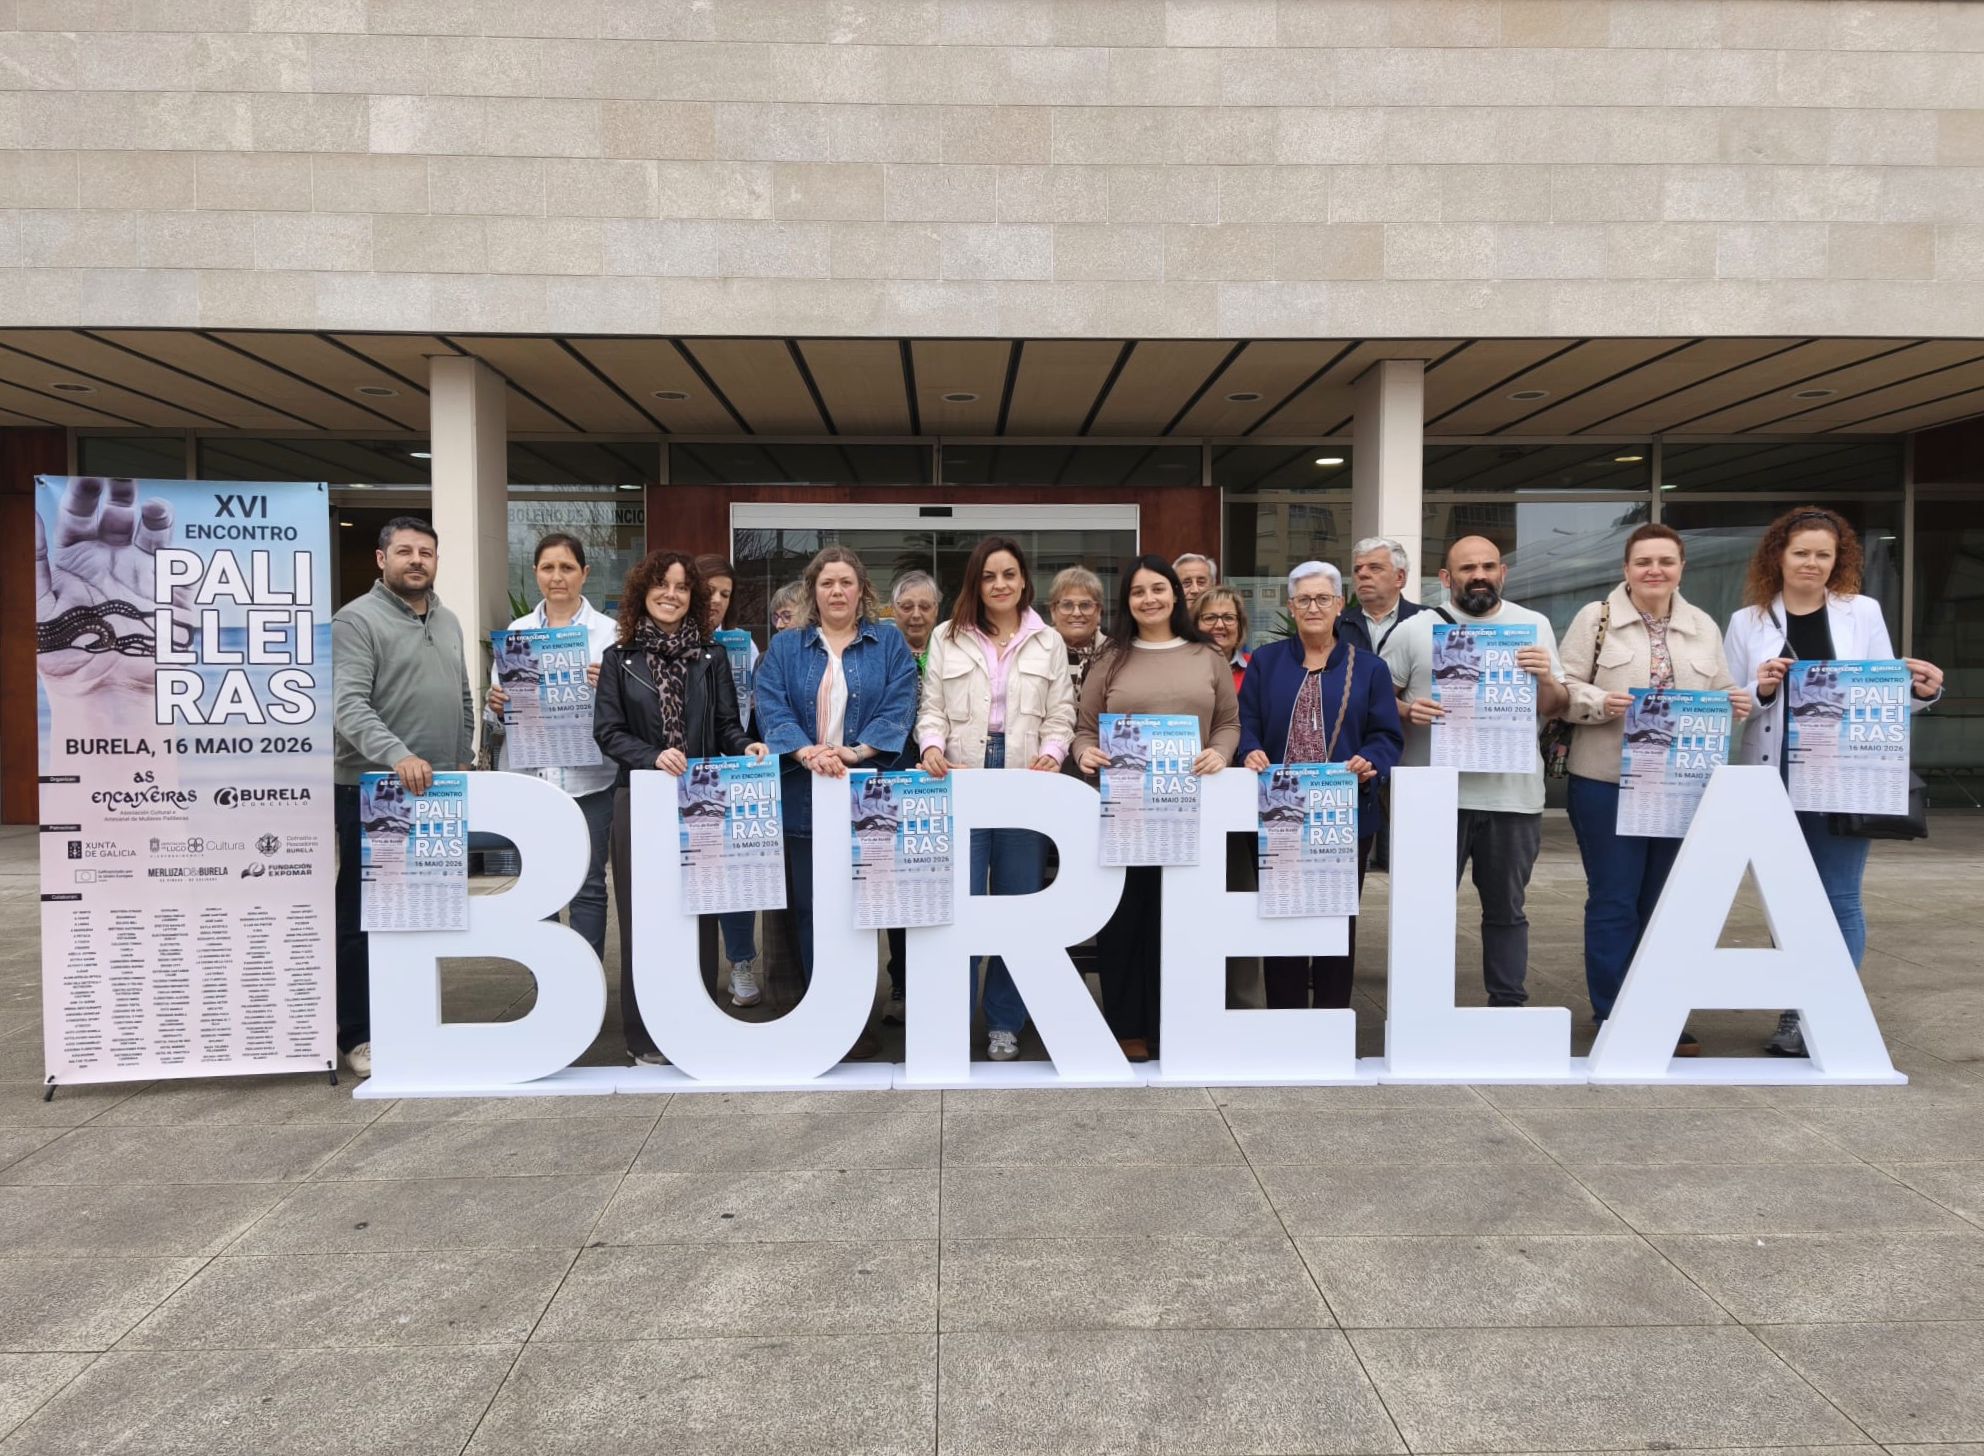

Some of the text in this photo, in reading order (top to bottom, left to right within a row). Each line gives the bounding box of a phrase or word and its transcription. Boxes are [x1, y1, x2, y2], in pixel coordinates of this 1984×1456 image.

[214, 494, 267, 518] XVI
[185, 524, 298, 541] ENCONTRO
[154, 548, 313, 605] PALI
[154, 608, 314, 665] LLEI
[552, 642, 584, 650] ENCONTRO
[541, 650, 587, 669] PALI
[1485, 650, 1520, 666] PA
[544, 667, 588, 687] LLEI
[1485, 667, 1532, 685] LLEI
[154, 668, 316, 725] RAS
[547, 686, 591, 704] RAS
[1485, 687, 1532, 703] RAS
[1850, 686, 1904, 704] PALI
[1850, 705, 1904, 723] LLEI
[1679, 715, 1726, 733] PALI
[1850, 724, 1905, 742] RAS
[66, 737, 313, 758] BURELA, 16 MAIO 2026
[1151, 739, 1197, 755] PALI
[1677, 733, 1725, 751] LLEI
[1675, 752, 1724, 770] RAS
[730, 781, 776, 801] PALI
[1152, 776, 1197, 794] RAS
[240, 788, 311, 801] BURELA
[1309, 789, 1353, 807] PALI
[415, 800, 462, 818] PALI
[731, 800, 777, 820] LLEI
[902, 797, 948, 815] PALI
[903, 816, 949, 835] LLEI
[1310, 808, 1353, 826] LLEI
[415, 820, 463, 837] LLEI
[732, 820, 778, 839] RAS
[1310, 827, 1354, 845] RAS
[85, 841, 117, 850] XUNTA
[85, 849, 137, 858] DE GALICIA
[205, 840, 245, 851] Cultura
[415, 839, 463, 857] RAS
[903, 835, 949, 854] RAS
[148, 867, 184, 877] MERLUZA
[199, 866, 229, 876] BURELA
[368, 764, 1895, 1083] BURELA
